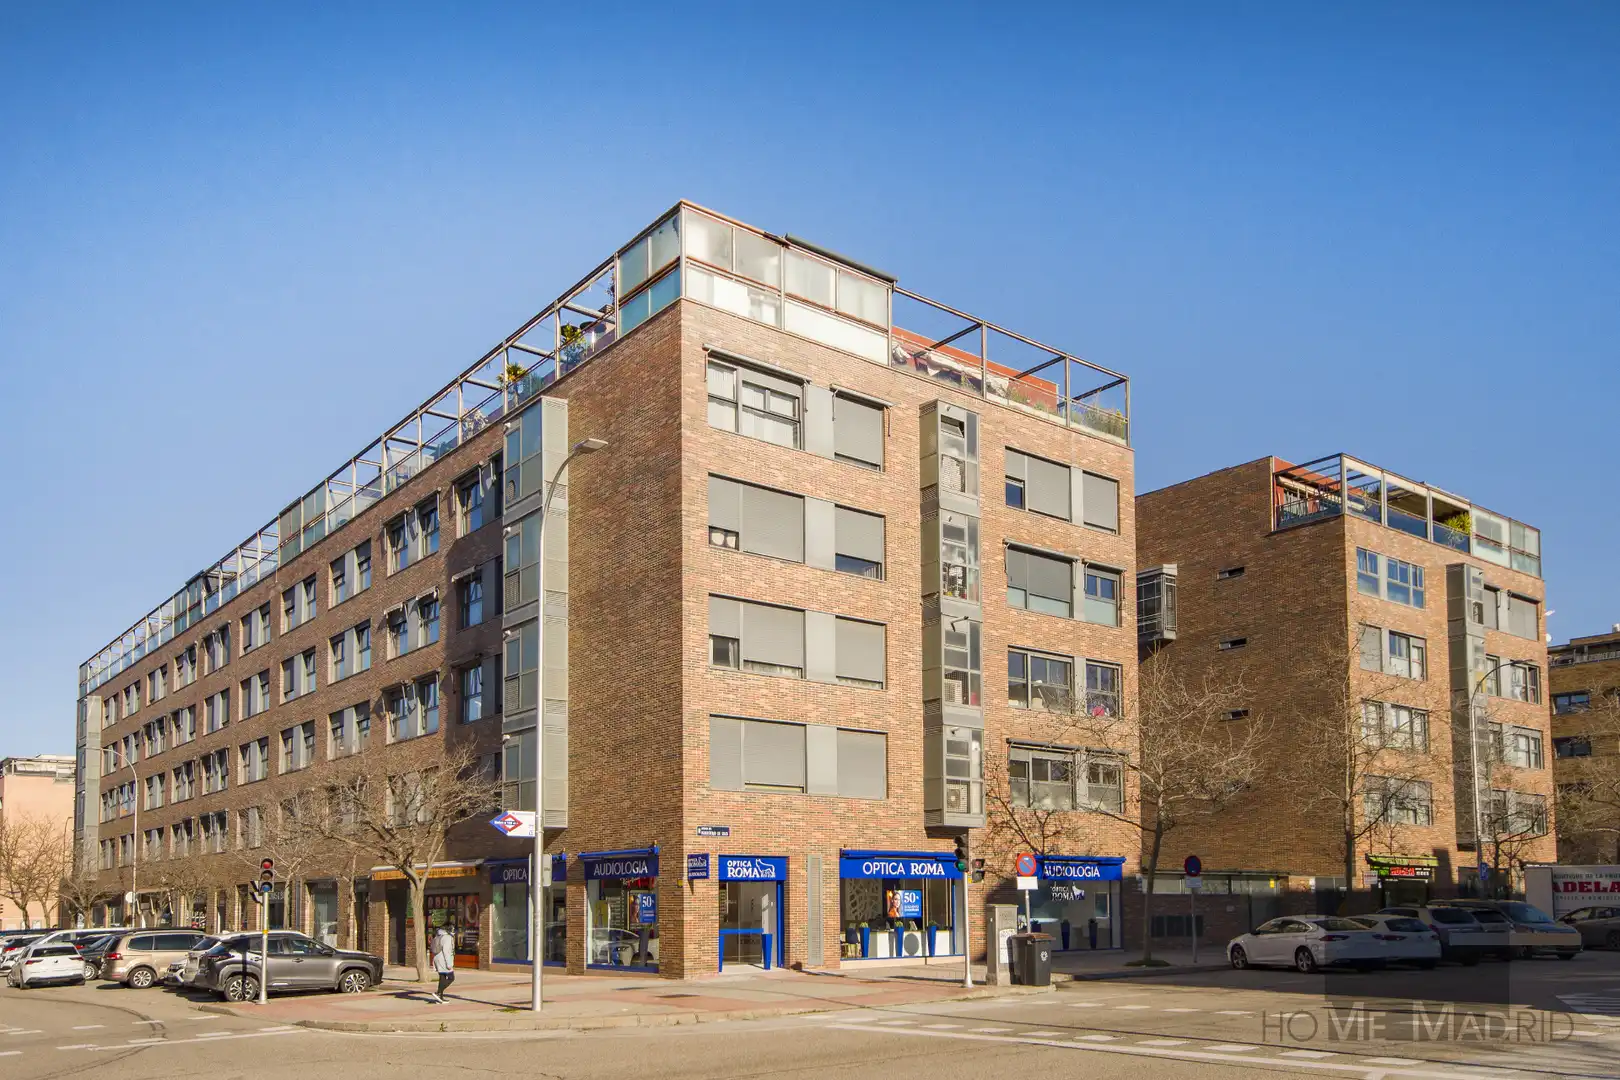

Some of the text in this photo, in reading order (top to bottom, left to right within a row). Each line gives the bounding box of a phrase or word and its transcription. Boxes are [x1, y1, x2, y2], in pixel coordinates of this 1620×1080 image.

[502, 867, 527, 881] OPTICA
[593, 860, 648, 876] AUDIOLOGIA
[727, 867, 760, 878] ROMA
[862, 862, 945, 876] OPTICA ROMA
[1043, 865, 1101, 878] AUDIOLOGIA
